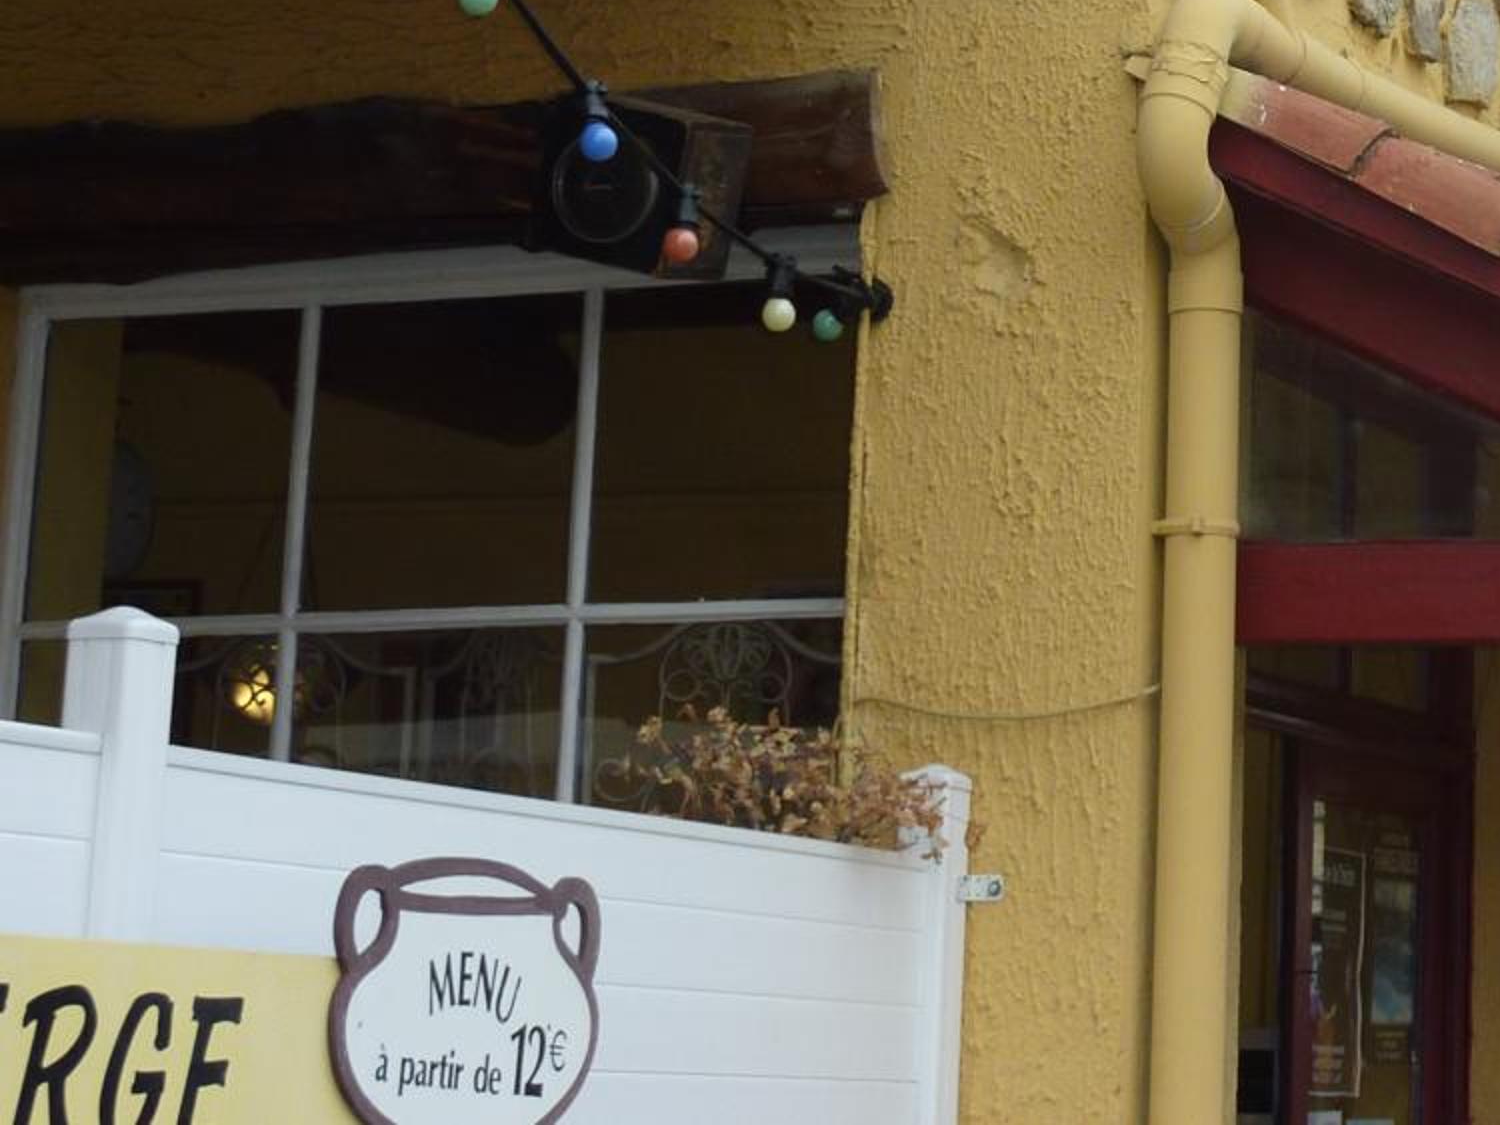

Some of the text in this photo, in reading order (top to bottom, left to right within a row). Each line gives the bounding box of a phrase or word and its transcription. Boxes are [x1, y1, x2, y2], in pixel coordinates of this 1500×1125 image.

[428, 951, 522, 1024] MENU
[0, 982, 245, 1125] RGE
[375, 1043, 389, 1082] à
[398, 1050, 464, 1097] partir
[473, 1053, 501, 1096] de
